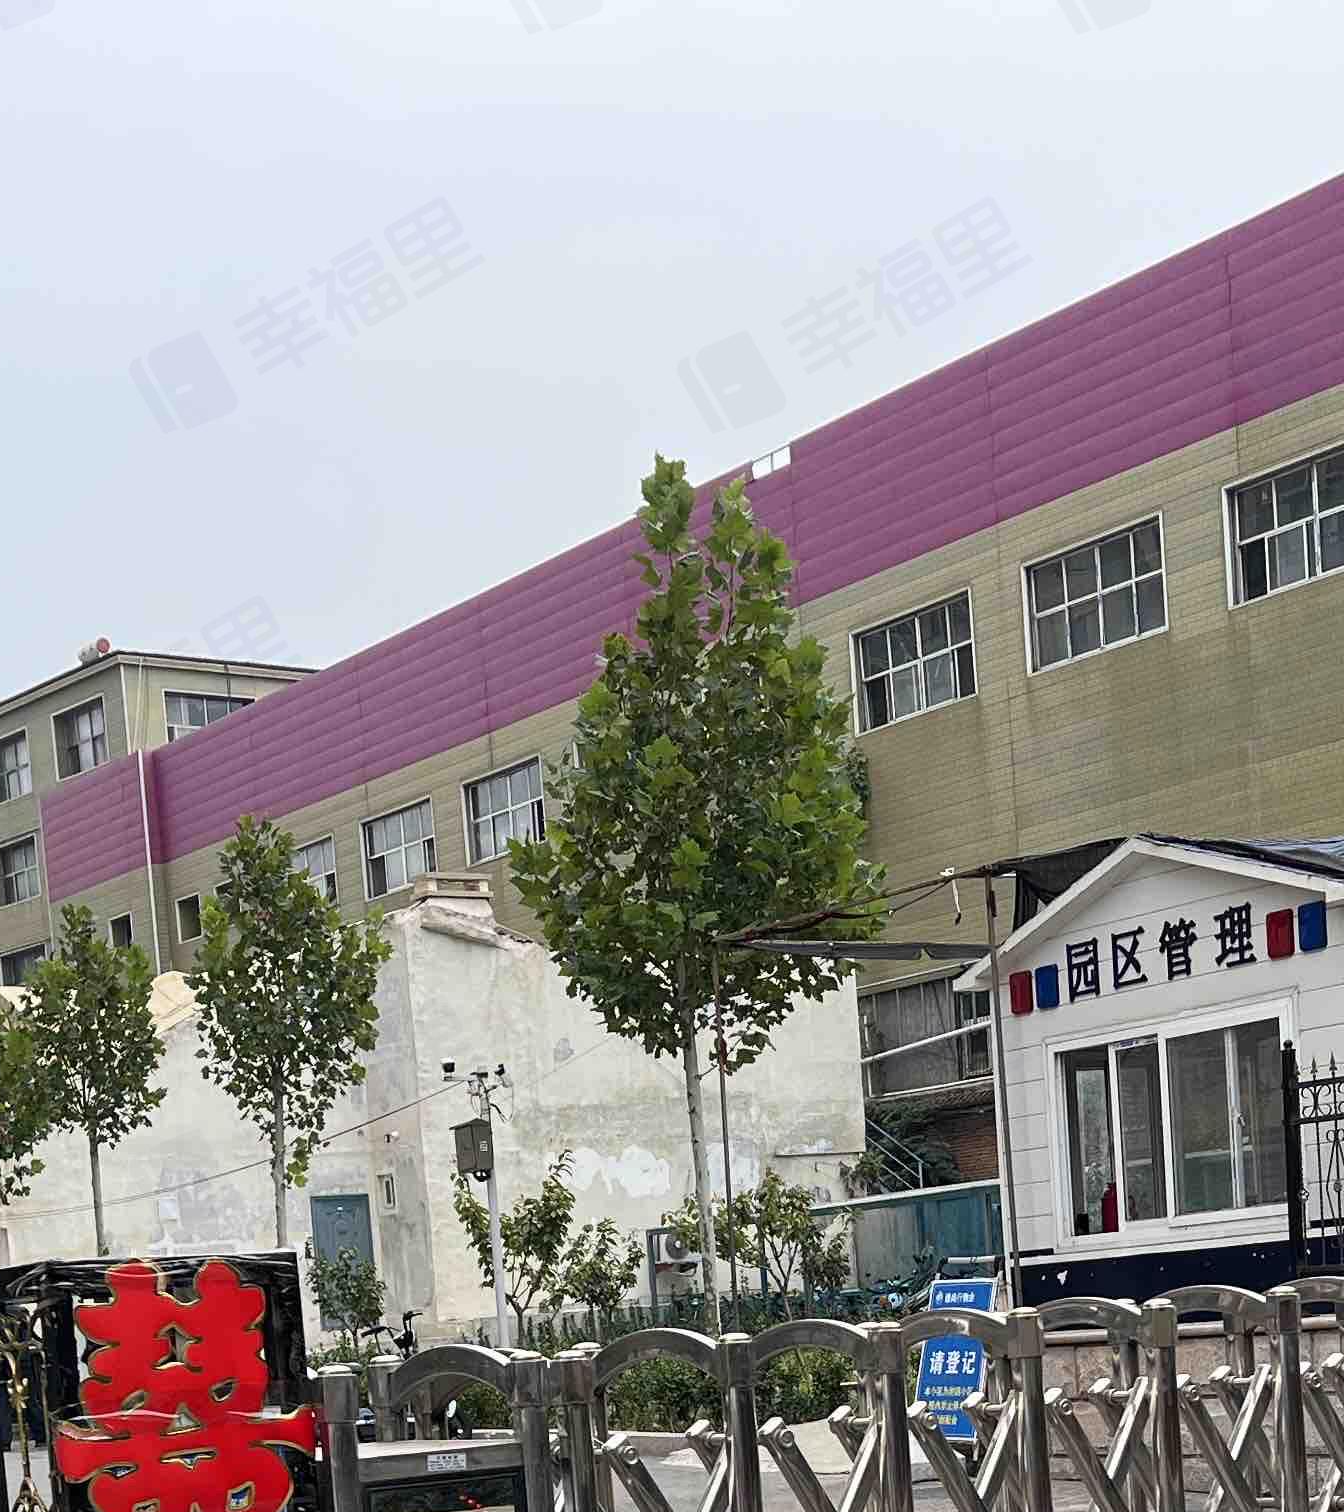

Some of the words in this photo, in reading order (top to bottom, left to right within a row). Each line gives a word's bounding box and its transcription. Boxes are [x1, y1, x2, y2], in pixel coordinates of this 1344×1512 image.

[1066, 902, 1258, 1002] 园区管理
[929, 1350, 976, 1375] 请登记
